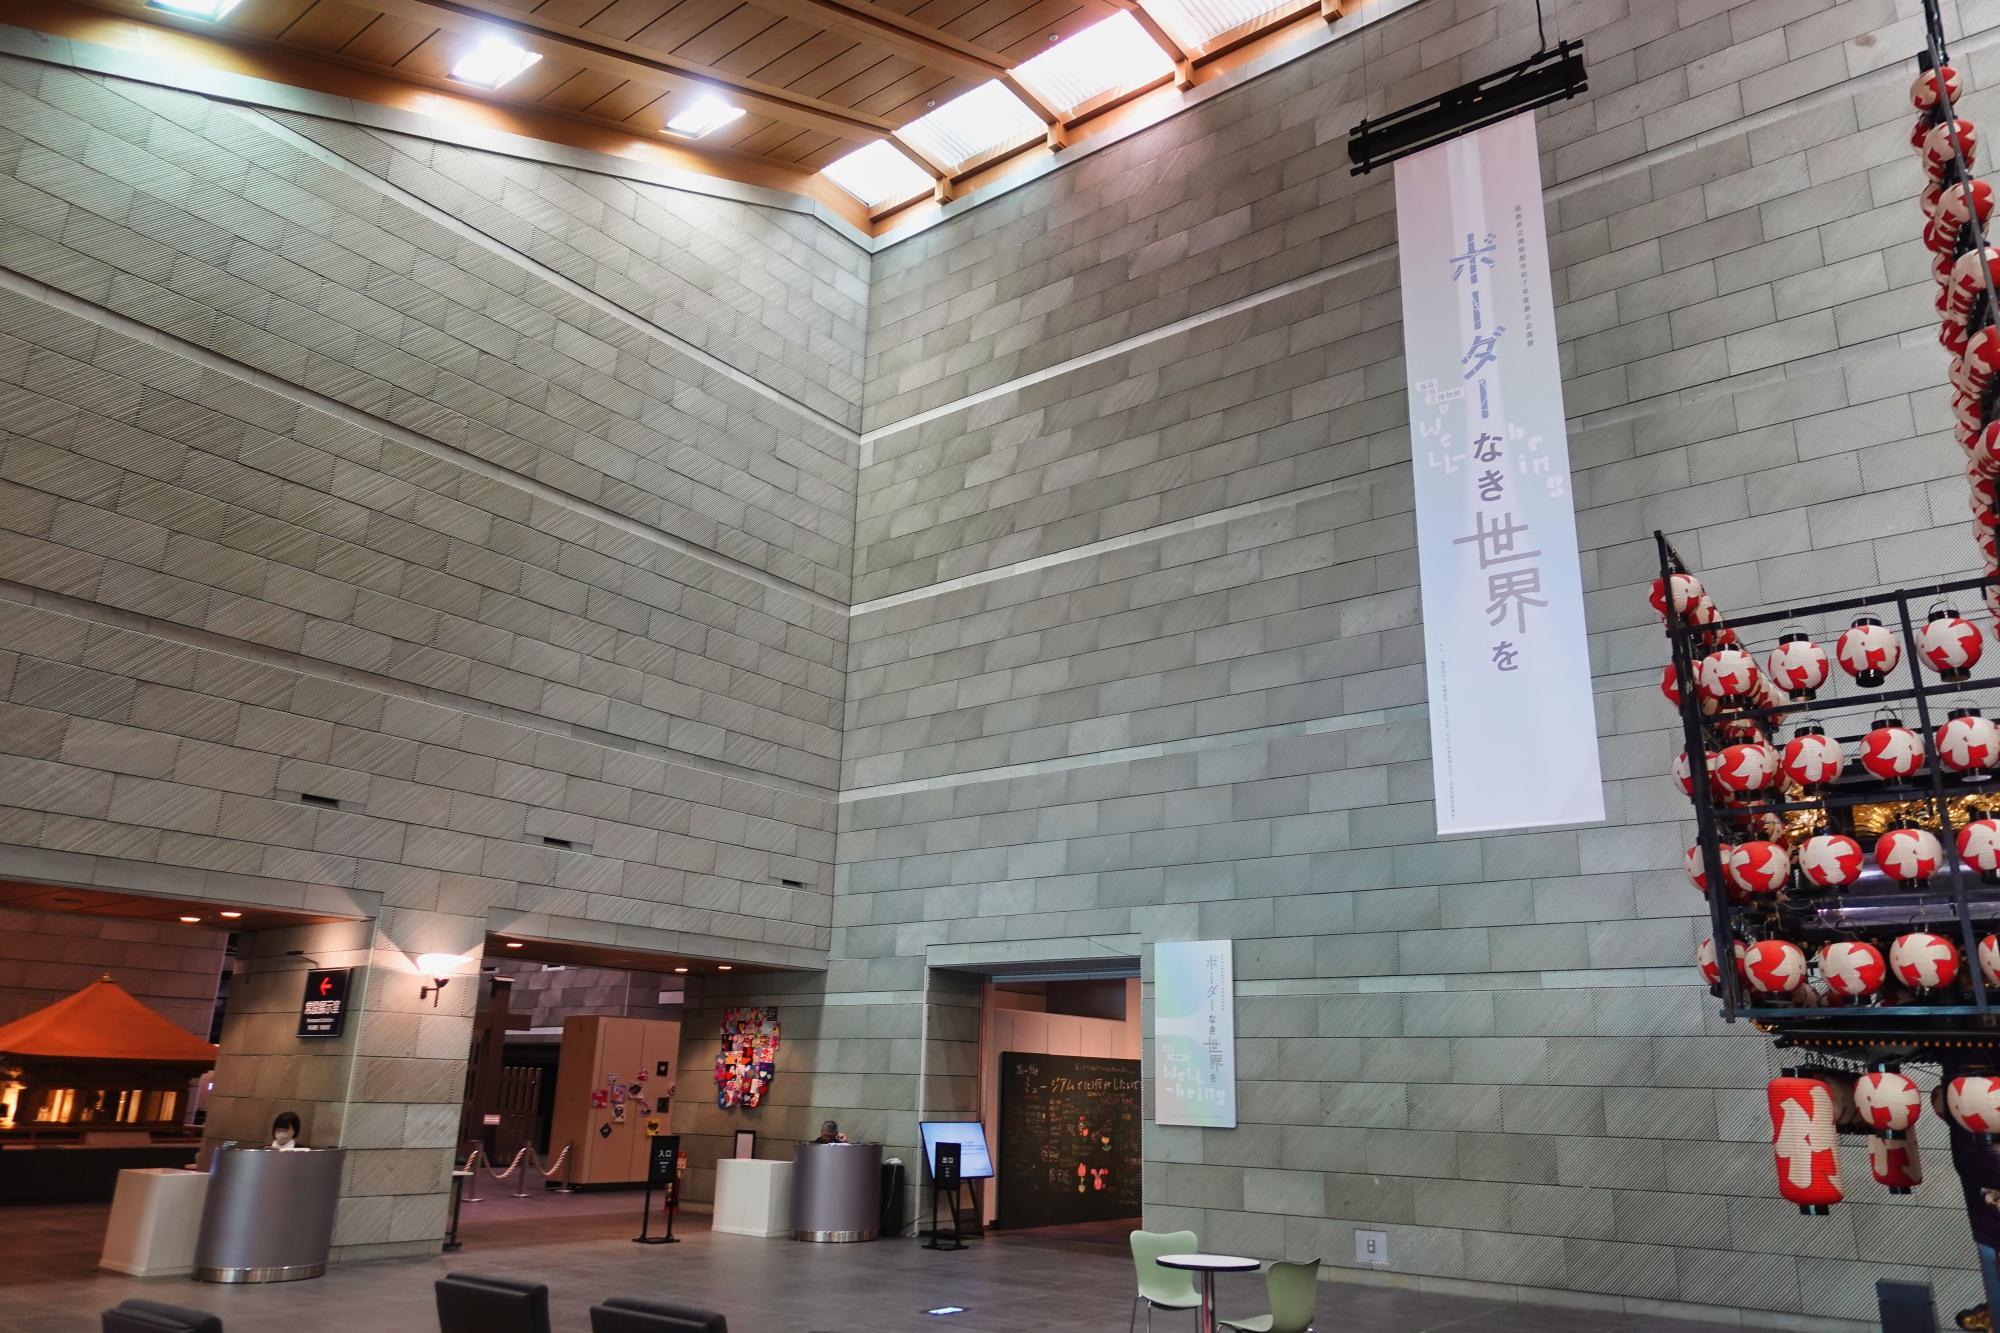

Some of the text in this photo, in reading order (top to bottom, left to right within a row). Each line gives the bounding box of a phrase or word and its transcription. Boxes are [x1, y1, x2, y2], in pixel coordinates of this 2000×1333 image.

[1449, 232, 1548, 671] ボーダーなき世界を
[304, 1000, 341, 1014] 常設展示室
[1203, 954, 1224, 1083] ボーダーなき世界を
[658, 1149, 672, 1158] 入口
[941, 1156, 954, 1164] 出口
